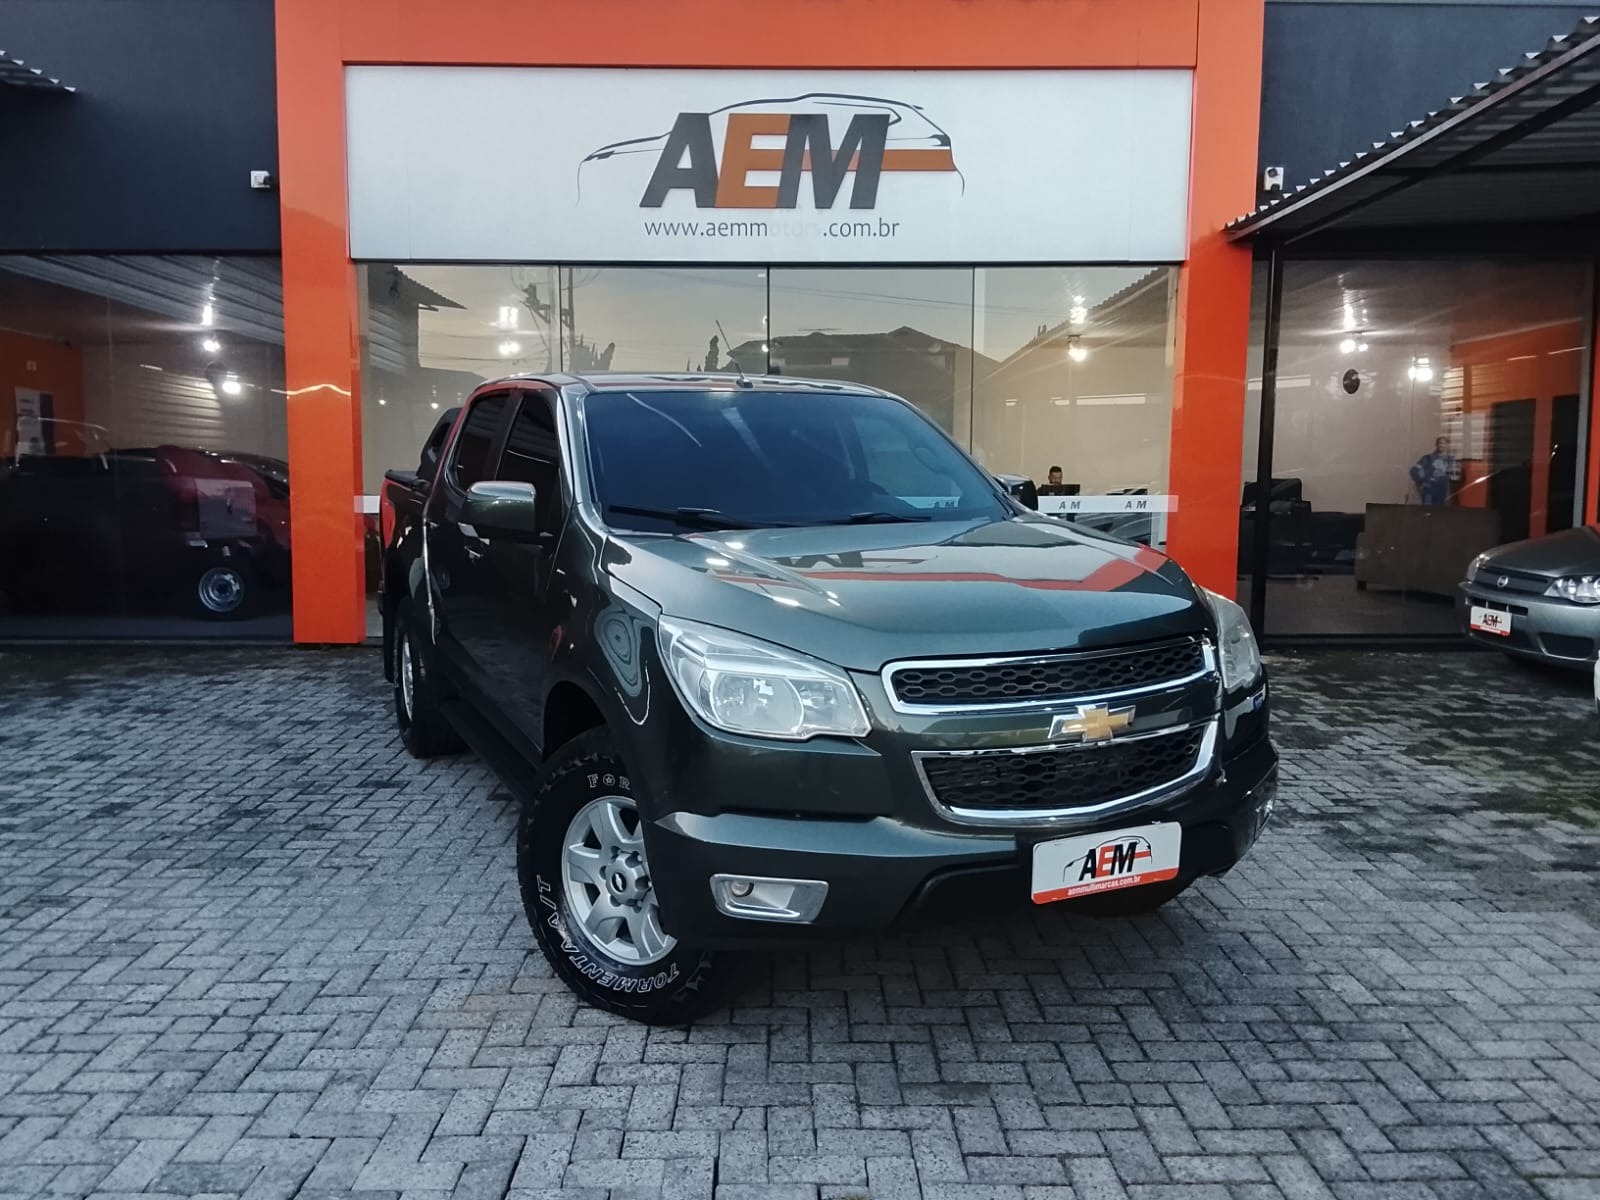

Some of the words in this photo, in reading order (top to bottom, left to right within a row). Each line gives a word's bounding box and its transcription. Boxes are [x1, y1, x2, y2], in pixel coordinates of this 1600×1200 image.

[638, 112, 891, 210] AEM
[1078, 841, 1138, 882] AEM
[560, 936, 680, 993] TORMENTA
